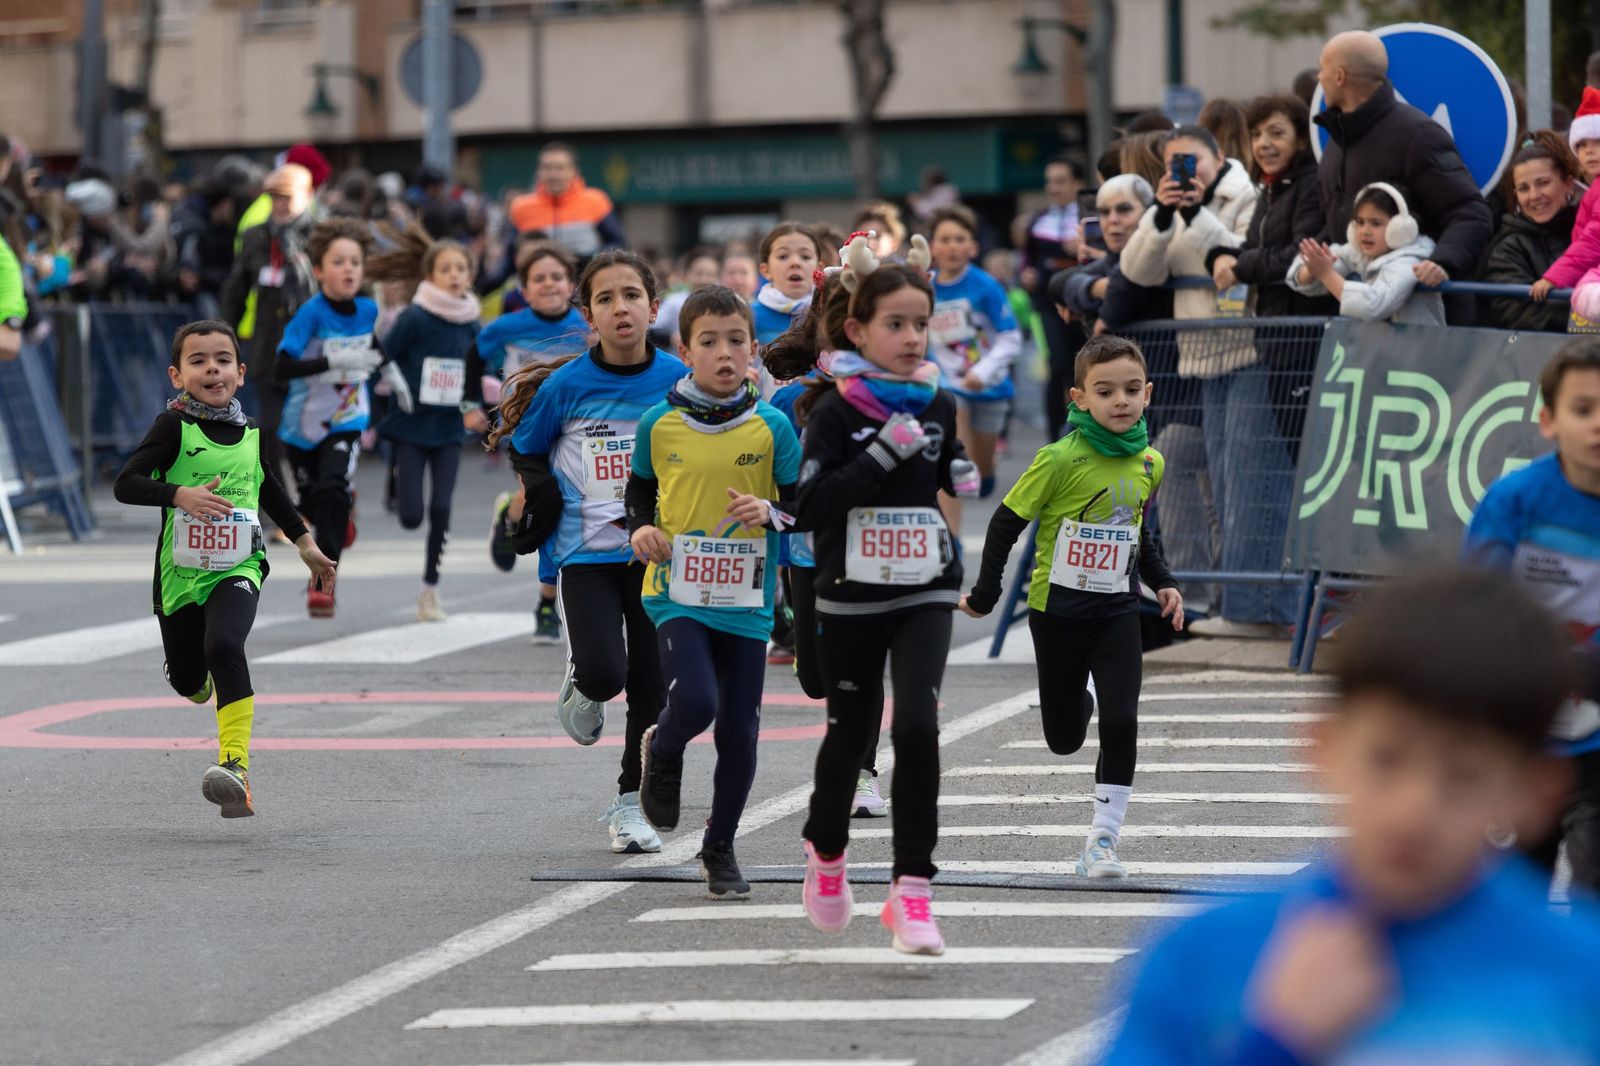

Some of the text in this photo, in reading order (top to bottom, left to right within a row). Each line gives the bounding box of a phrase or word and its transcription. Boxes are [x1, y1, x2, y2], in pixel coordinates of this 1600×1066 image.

[876, 513, 937, 525] SETEL
[188, 525, 237, 550] 6851
[862, 529, 926, 558] 6963
[1080, 527, 1132, 541] SETEL
[700, 542, 757, 554] SETEL
[1067, 540, 1119, 571] 6821
[684, 556, 744, 584] 6865
